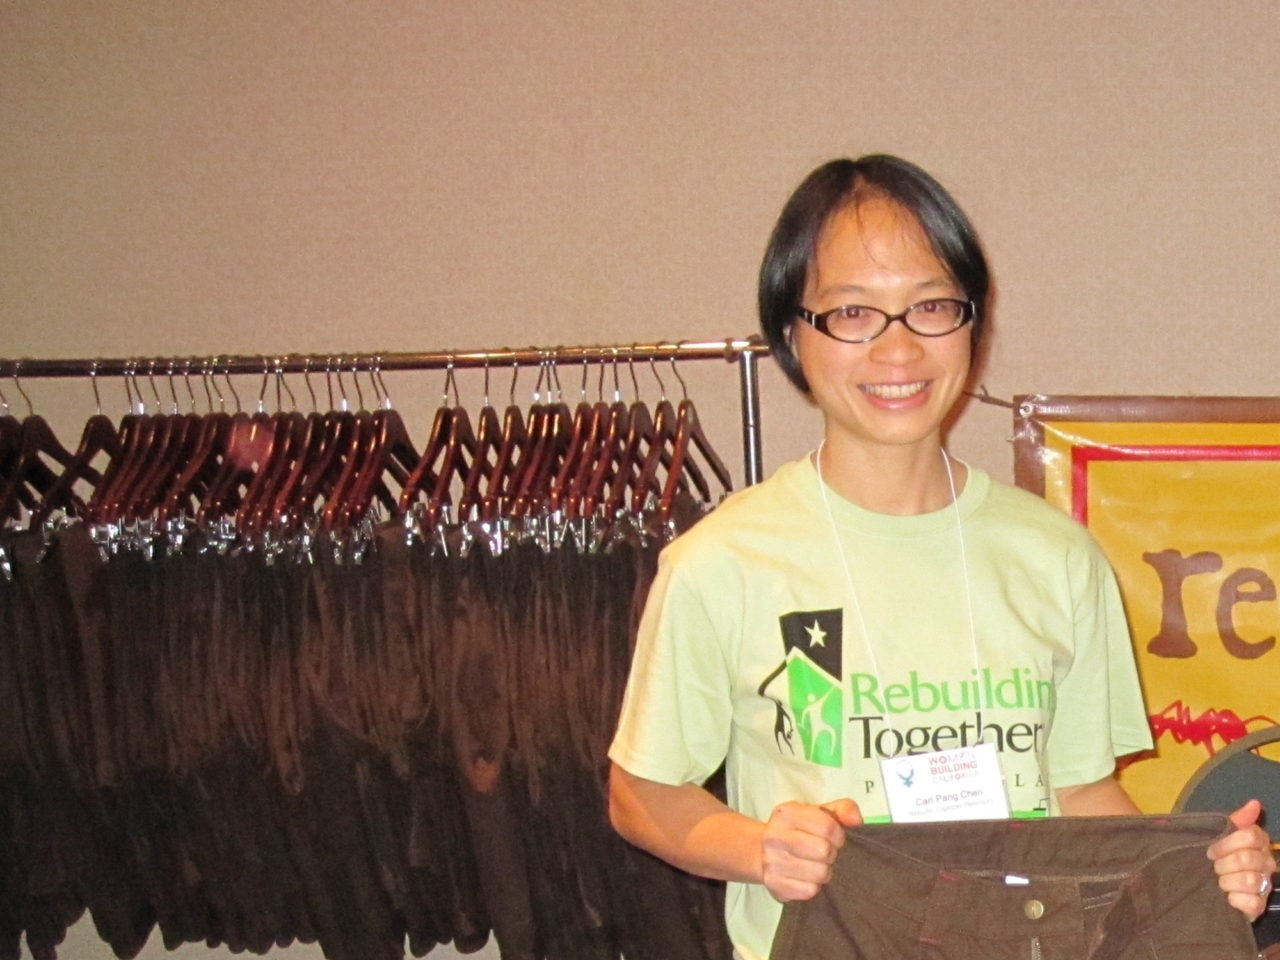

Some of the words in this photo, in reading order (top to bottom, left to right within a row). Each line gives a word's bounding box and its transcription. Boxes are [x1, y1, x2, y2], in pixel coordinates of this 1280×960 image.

[849, 667, 1052, 715] Rebuildin
[849, 711, 1045, 758] Together
[930, 760, 978, 776] BUILDING
